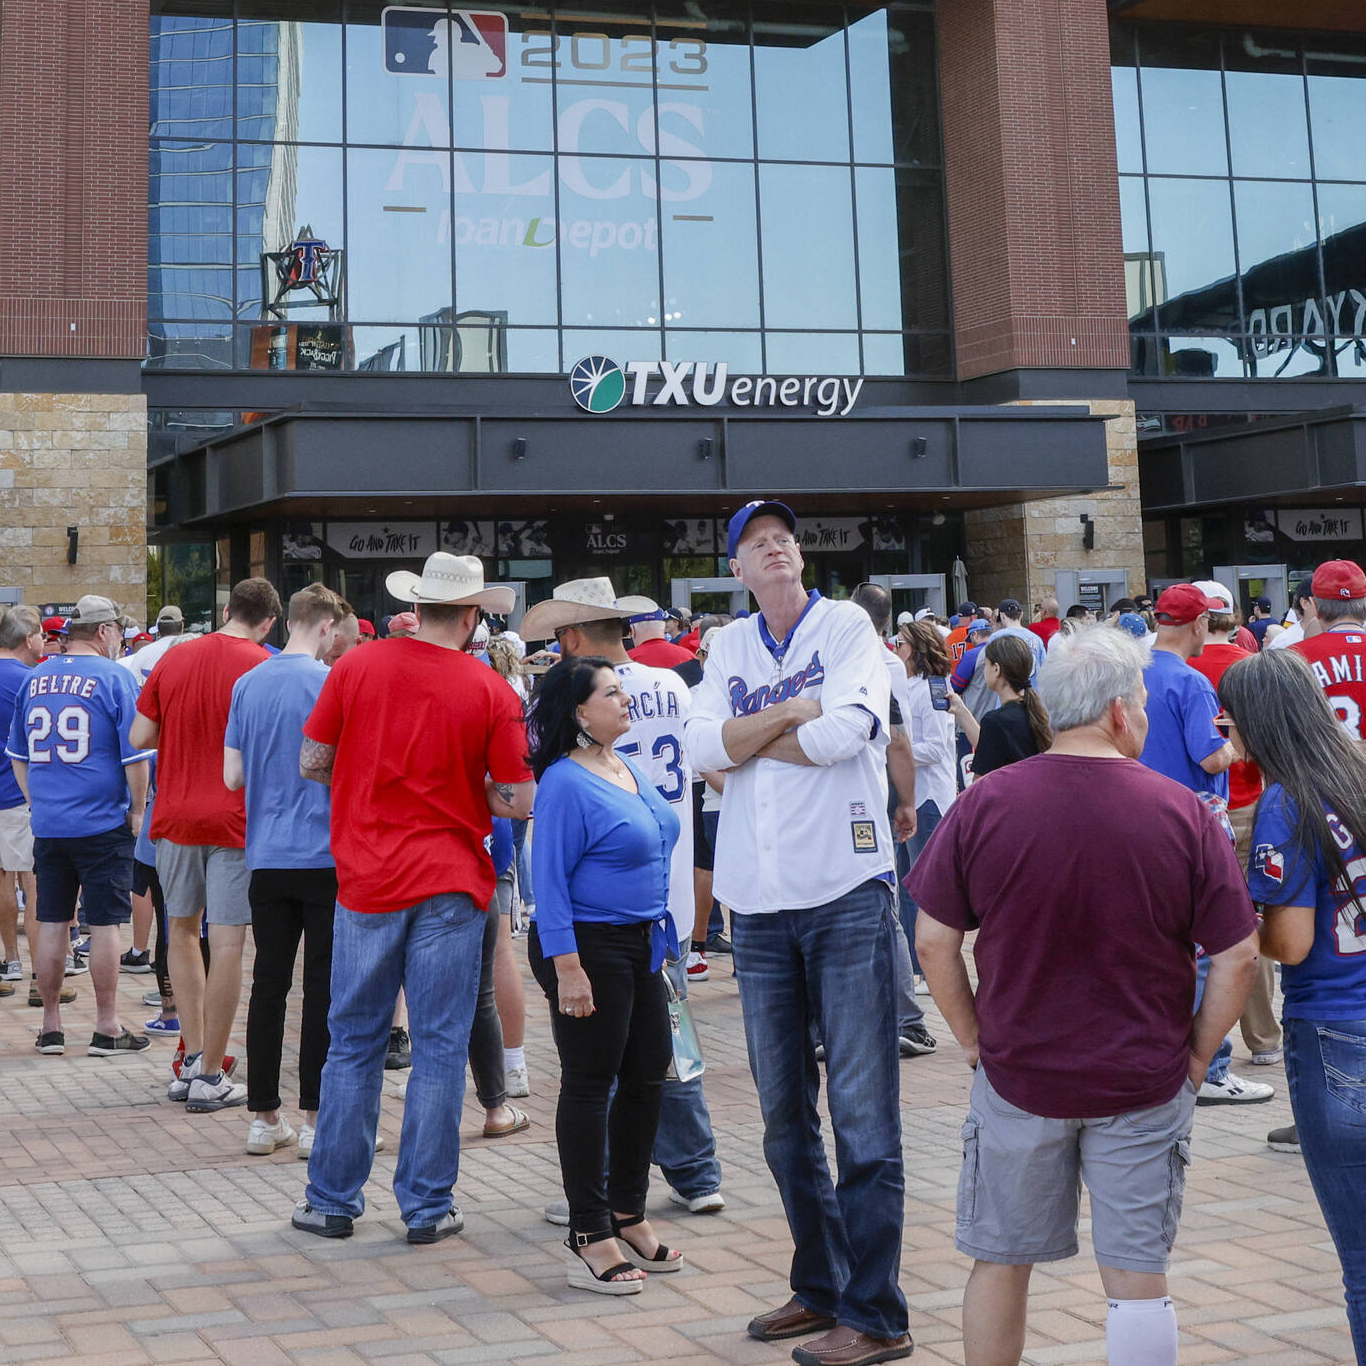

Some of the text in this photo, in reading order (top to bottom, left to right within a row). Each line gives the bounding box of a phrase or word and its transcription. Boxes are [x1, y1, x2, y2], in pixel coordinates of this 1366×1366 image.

[520, 29, 709, 75] 2023
[382, 91, 713, 203] ALCS
[435, 207, 659, 258] loanDepot
[625, 359, 865, 417] TXU energy
[349, 535, 365, 552] GO
[586, 534, 627, 548] ALCS
[29, 674, 98, 700] BELTRE
[628, 681, 681, 722] RCÍA
[27, 705, 92, 765] 29
